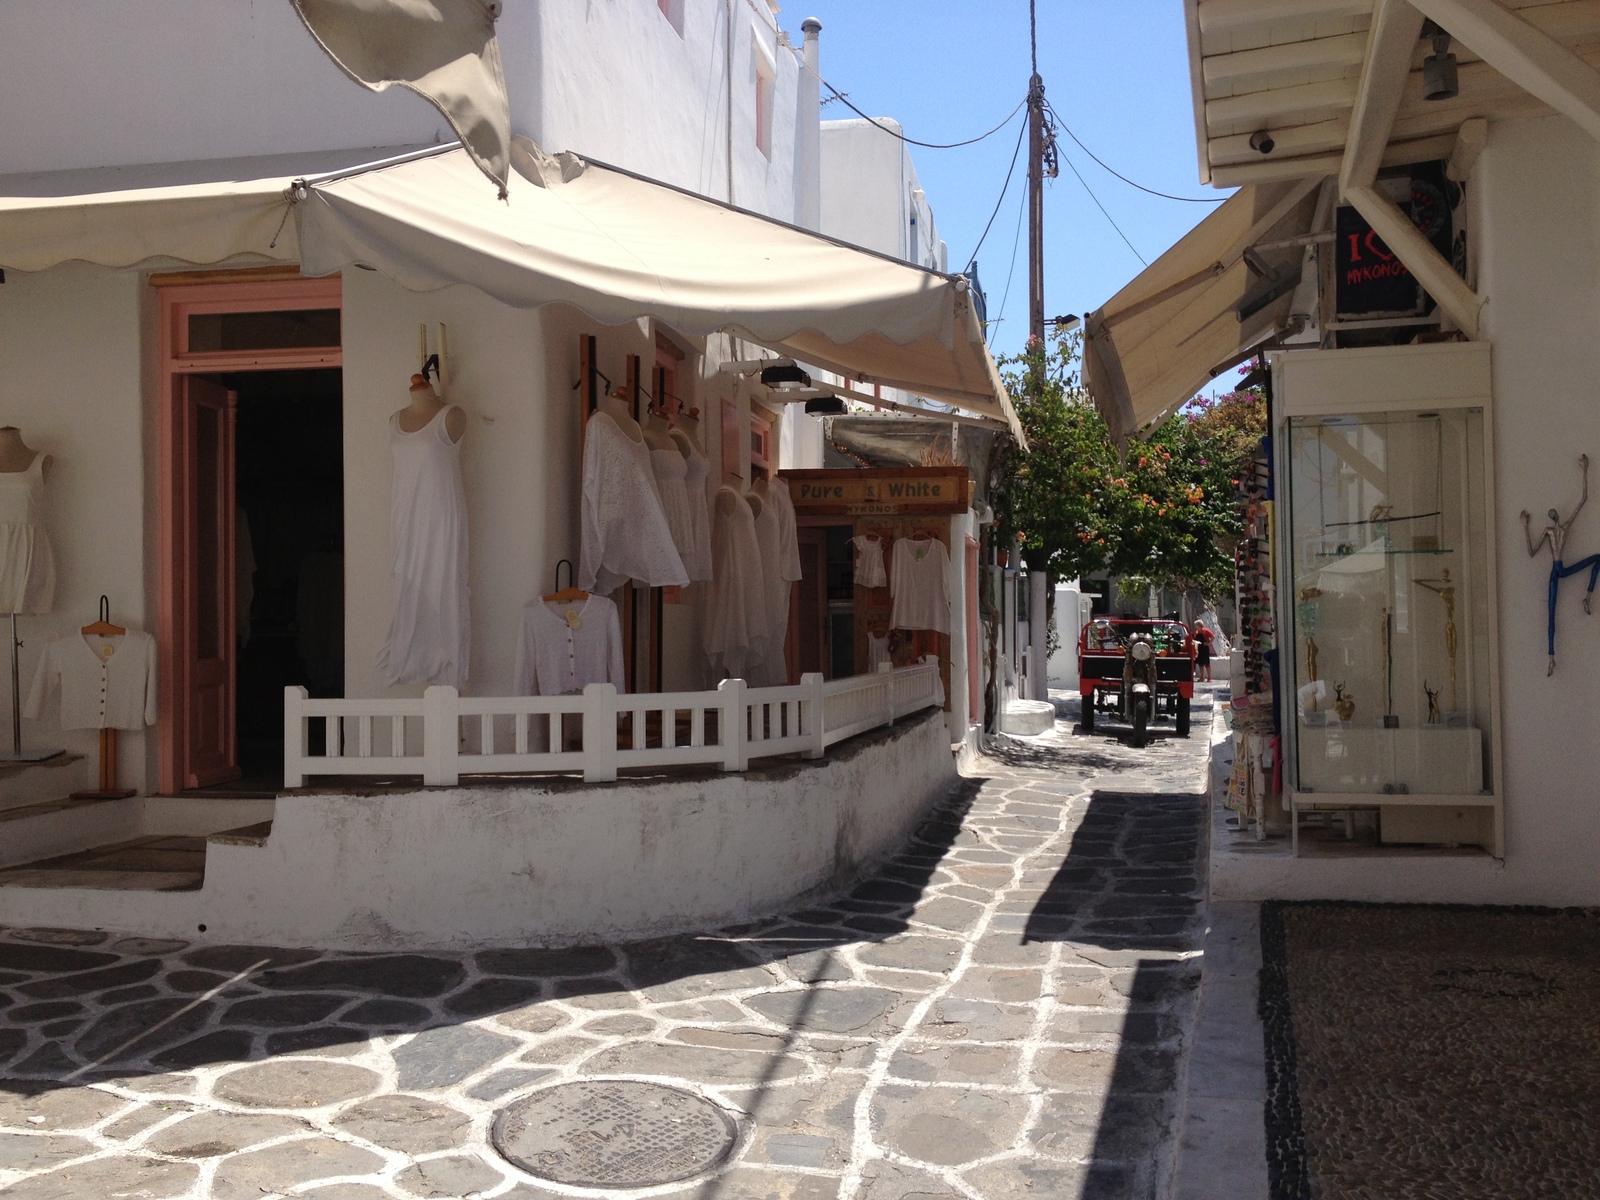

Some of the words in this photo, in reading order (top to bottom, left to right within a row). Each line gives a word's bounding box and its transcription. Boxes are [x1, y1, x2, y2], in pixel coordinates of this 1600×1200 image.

[1348, 233, 1362, 262] I
[801, 484, 843, 498] Pure
[888, 481, 941, 497] White
[848, 504, 899, 513] MYKONOS
